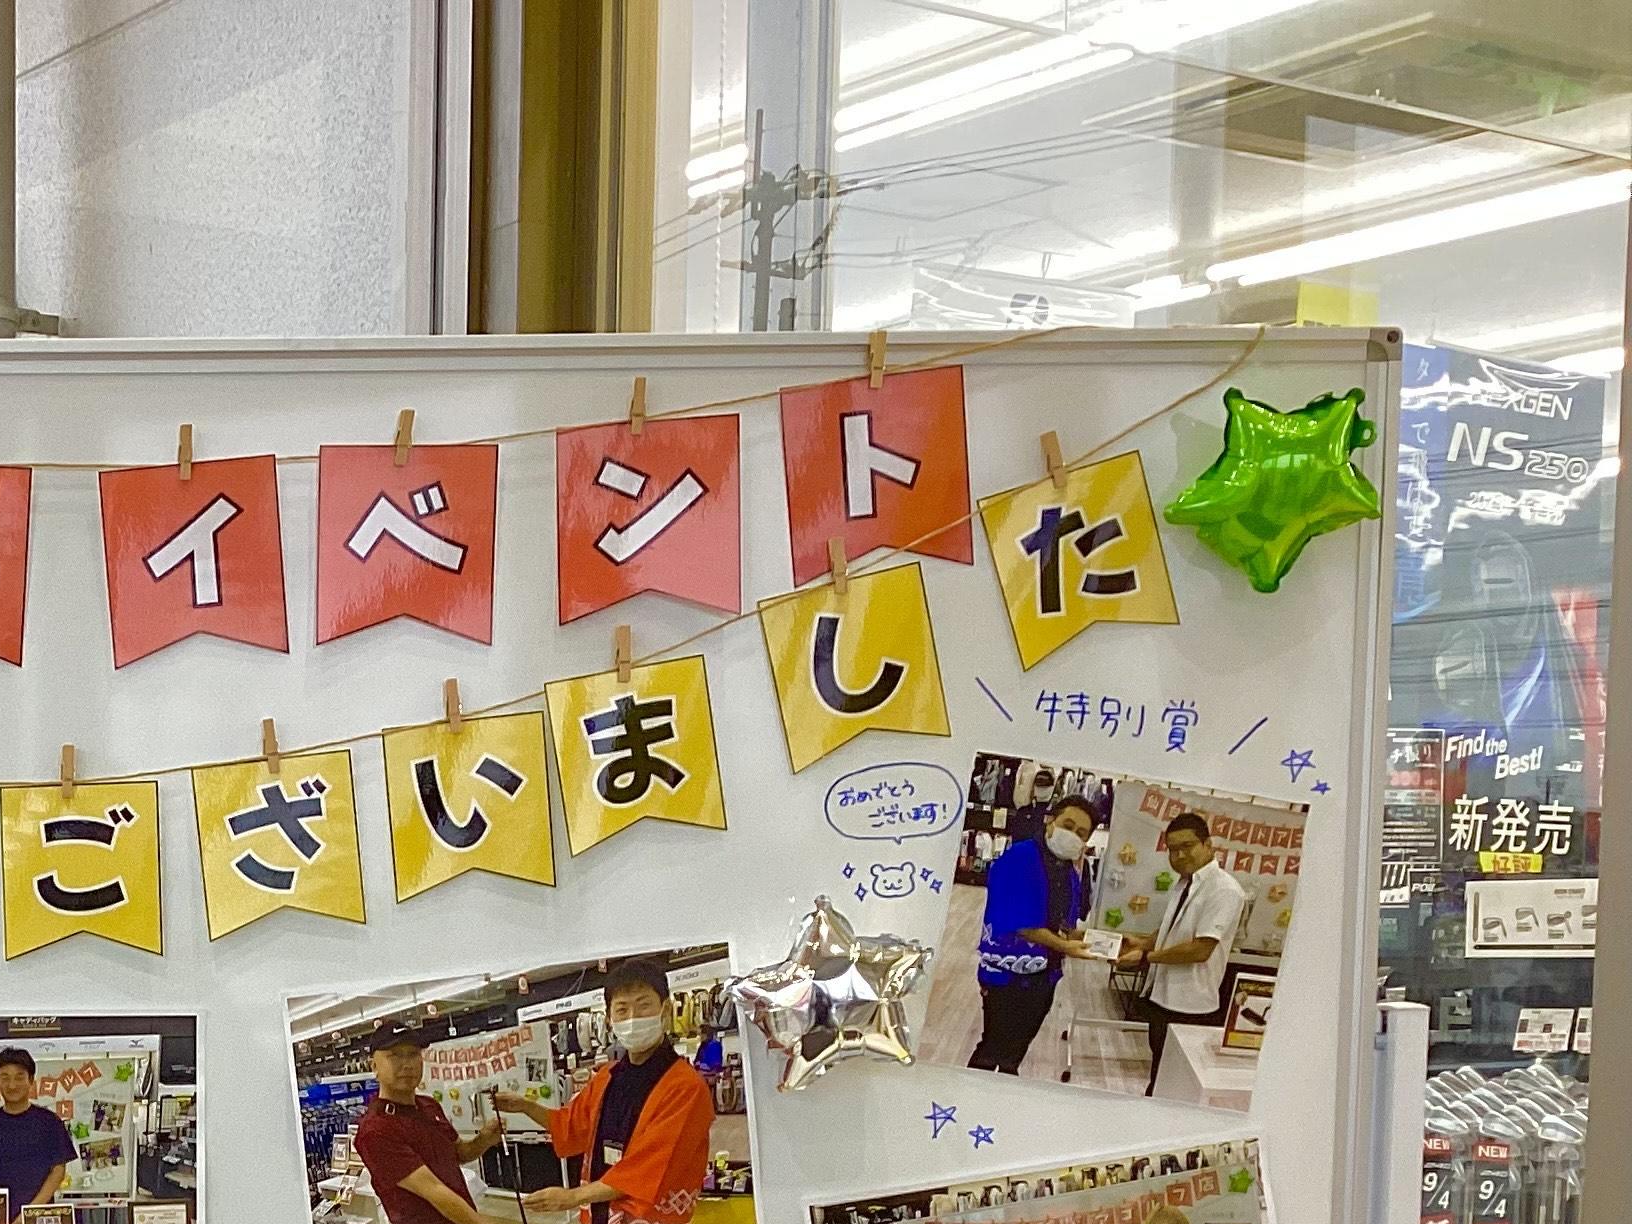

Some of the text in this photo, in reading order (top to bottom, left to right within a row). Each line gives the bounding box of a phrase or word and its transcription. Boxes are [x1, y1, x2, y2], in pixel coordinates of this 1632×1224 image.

[1035, 689, 1199, 753] 特別賞
[1445, 729, 1486, 761] Find
[1486, 738, 1508, 755] the
[1494, 746, 1544, 780] Best!
[837, 779, 915, 807] おめでとう
[1448, 793, 1575, 855] 新発売
[1423, 1138, 1450, 1150] NEW
[1478, 1145, 1508, 1158] NEW
[1422, 1172, 1450, 1209] 9/4
[1478, 1180, 1507, 1218] 9/4
